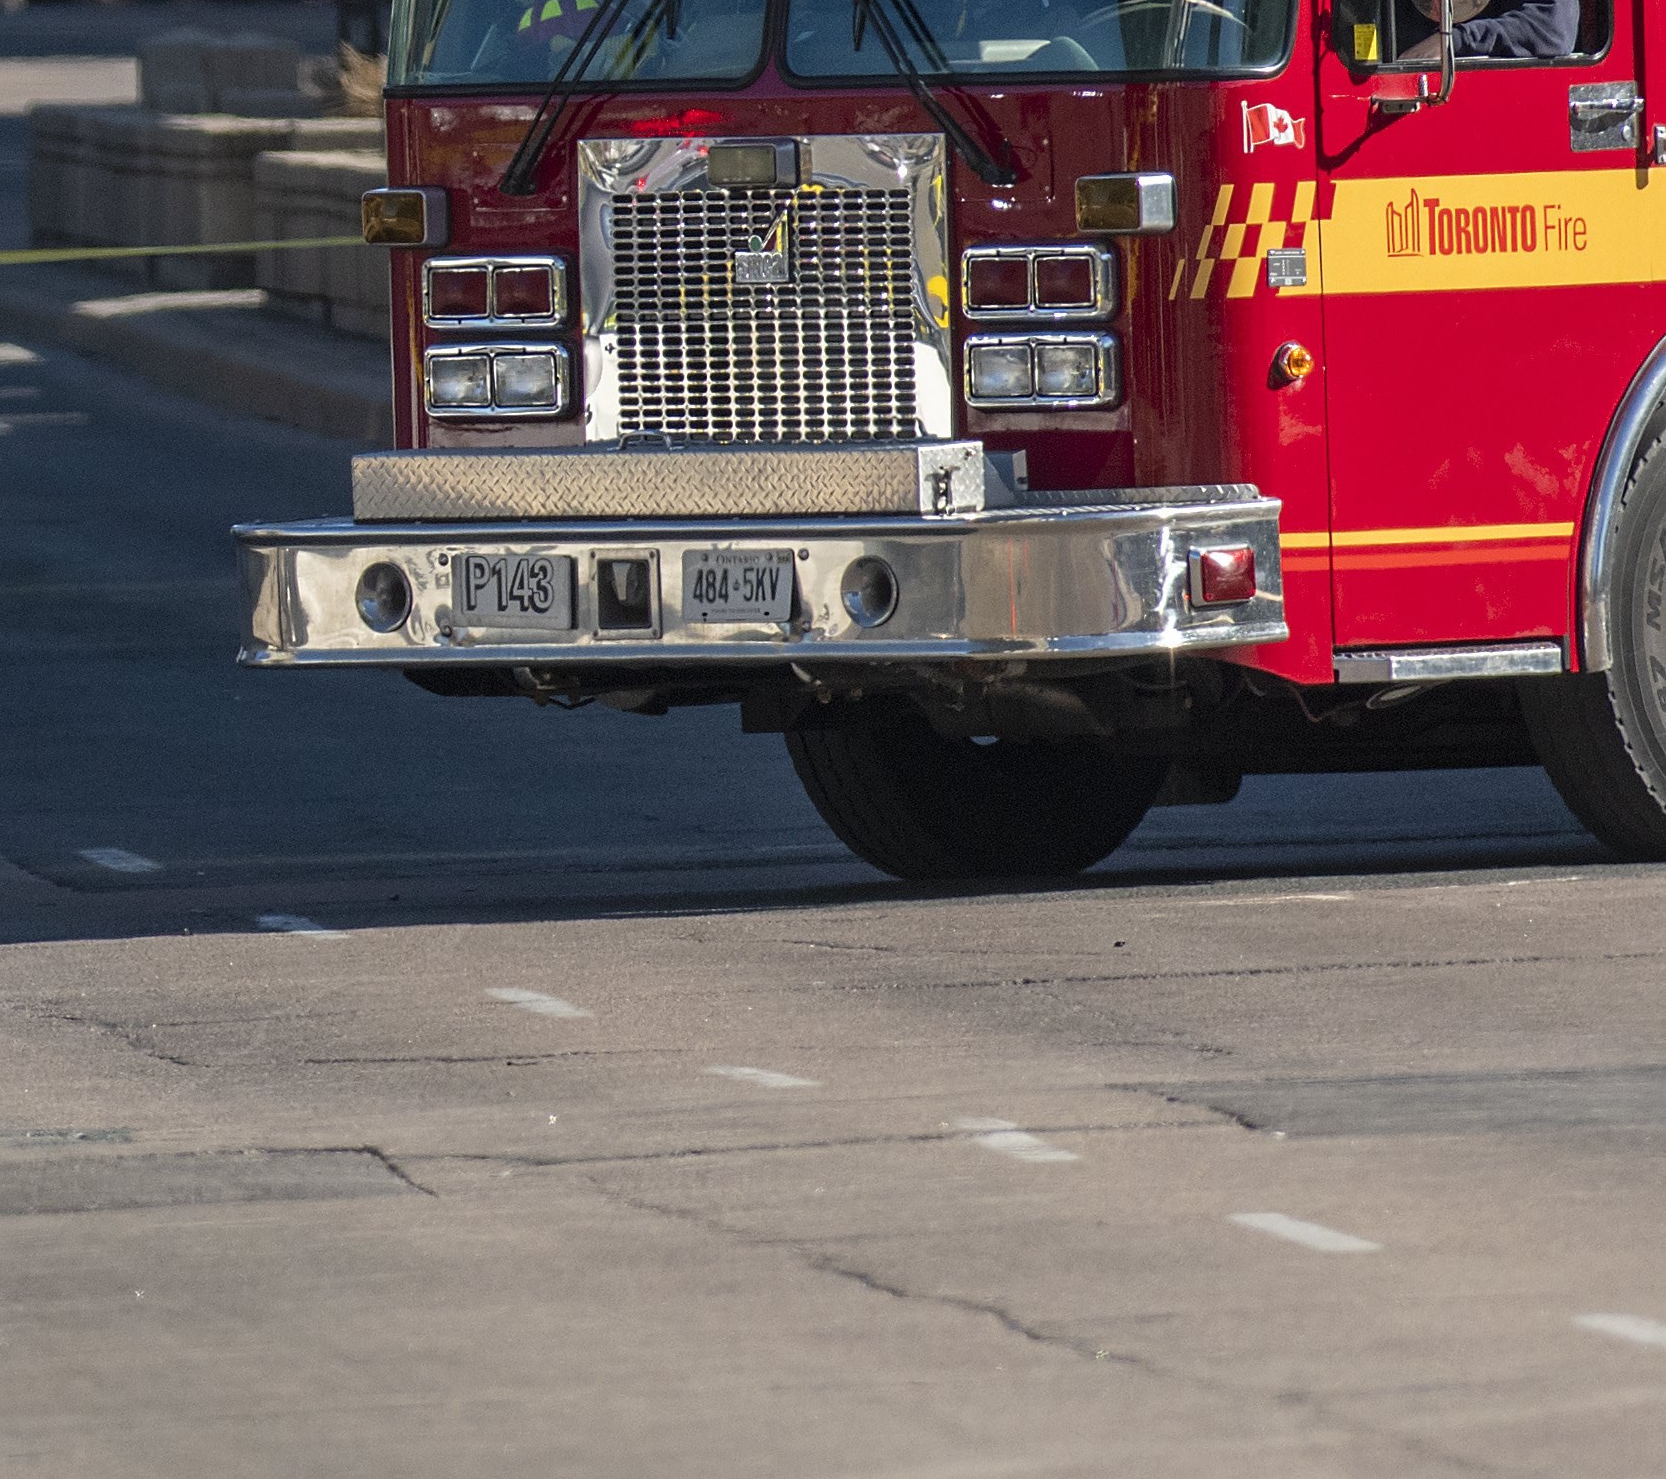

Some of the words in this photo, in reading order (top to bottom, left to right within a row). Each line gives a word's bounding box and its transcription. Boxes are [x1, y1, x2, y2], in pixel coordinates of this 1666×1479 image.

[1423, 198, 1537, 255] TORONTO
[1543, 204, 1587, 251] Fire
[465, 554, 555, 613] P143
